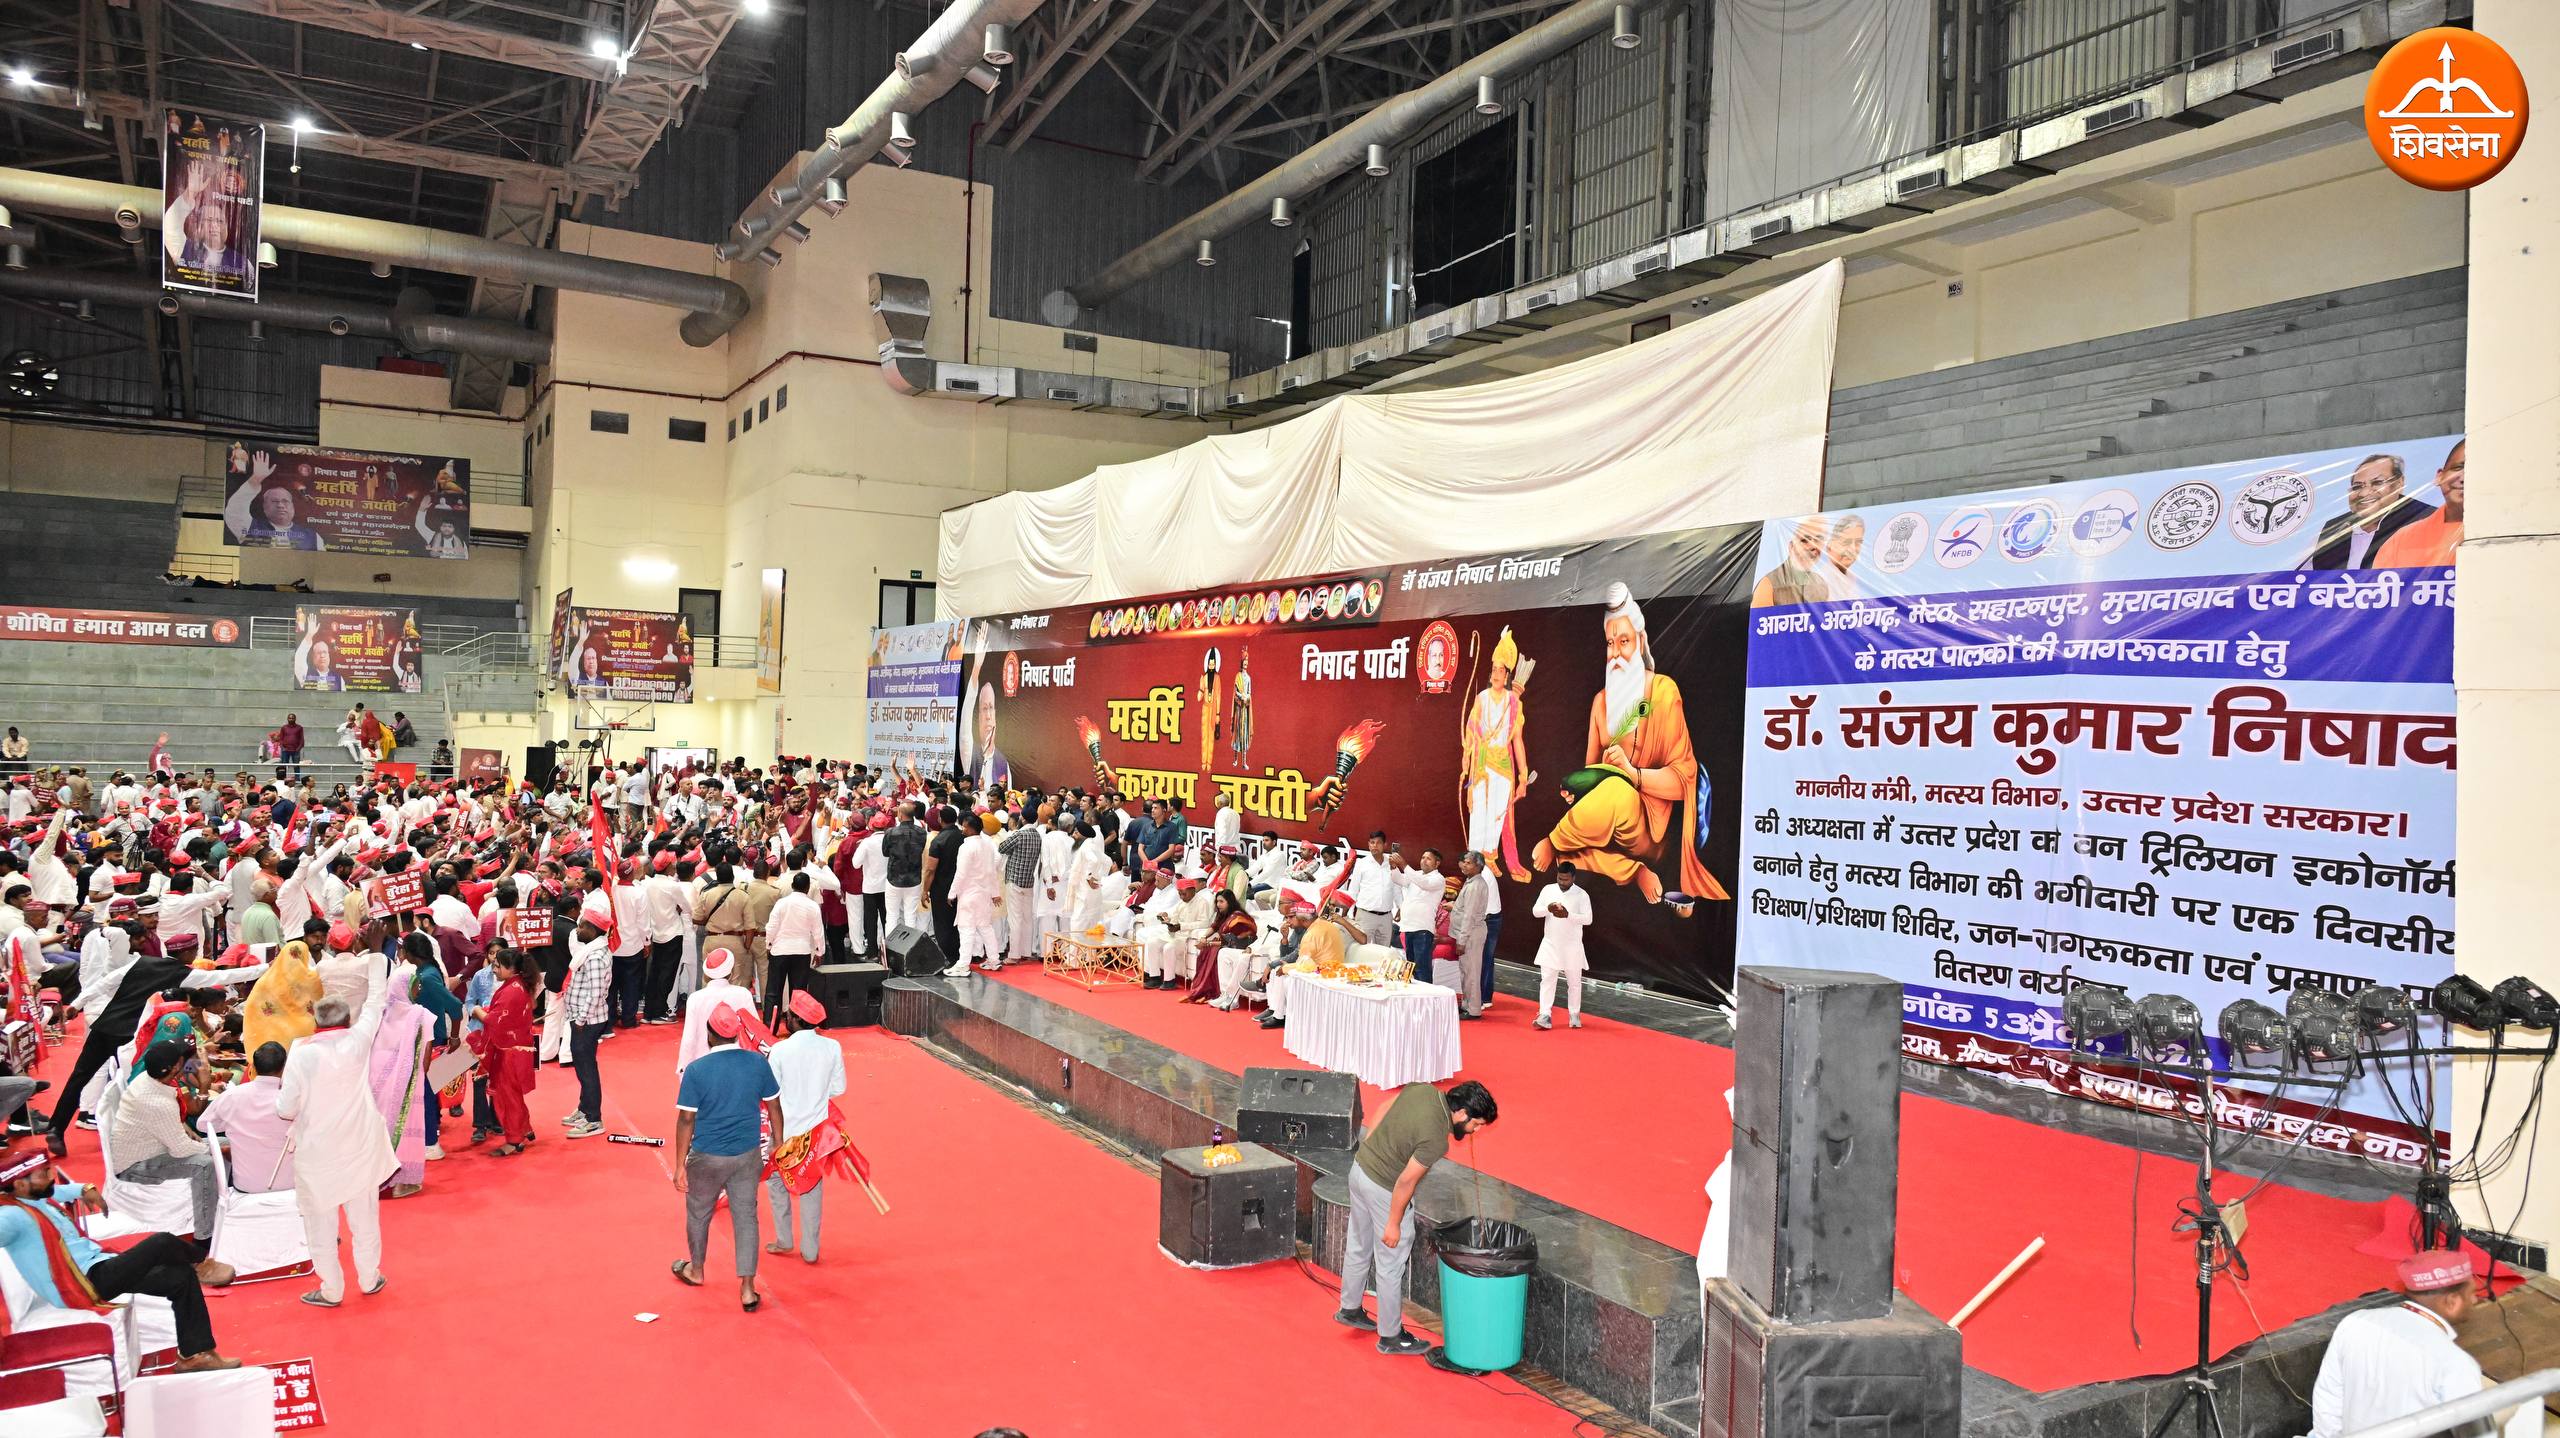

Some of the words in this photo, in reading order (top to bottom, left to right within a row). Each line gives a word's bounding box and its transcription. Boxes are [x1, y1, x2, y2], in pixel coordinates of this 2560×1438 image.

[314, 479, 358, 496] महर्षि
[315, 467, 338, 477] निषाद
[340, 469, 357, 479] पार्टी
[316, 498, 354, 509] कश्यप
[362, 498, 398, 512] जयंती
[1951, 550, 1972, 558] NFDB
[1401, 569, 1417, 591] डॉ
[1417, 566, 1453, 591] संजय
[1454, 562, 1496, 587] निषाद
[1498, 556, 1564, 583] जिंदाबाद
[1756, 612, 1816, 637] आगरा,
[1820, 601, 1902, 633] अलीगढ़,
[1968, 593, 2088, 627] सहारनपुर,
[2100, 585, 2240, 624] मुरादाबाद
[2248, 574, 2307, 610] एवं
[2308, 570, 2404, 610] बरेली
[7, 611, 69, 633] शोषित
[73, 618, 126, 636] हमारा
[129, 621, 171, 638] आम
[175, 623, 208, 639] दल
[1021, 660, 1051, 687] निषाद
[1052, 656, 1076, 687] पार्टी
[1301, 643, 1359, 681] निषाद
[1363, 636, 1410, 680] पार्टी
[1854, 643, 1878, 671] के
[1881, 647, 1937, 670] मत्स्य
[1942, 633, 2020, 667] पालकों
[2021, 631, 2059, 663] की
[2063, 638, 2228, 664] जागरूकता
[2235, 631, 2290, 679] हेतु
[871, 702, 879, 723] डॉ.
[882, 701, 902, 722] संजय
[905, 706, 928, 731] कुमार
[930, 699, 956, 722] निषाद
[1107, 685, 1185, 743] महर्षि
[1763, 694, 1824, 751] डॉ.
[1841, 690, 1979, 749] संजय
[1991, 702, 2191, 775] कुमार
[2206, 685, 2457, 772] निषाद
[1795, 774, 1868, 801] माननीय
[1871, 774, 1917, 805] मंत्री,
[1924, 782, 1985, 805] मत्स्य
[1991, 777, 2069, 812] विभाग,
[2082, 787, 2164, 817] उत्तर
[2172, 790, 2252, 824] प्रदेश
[2263, 802, 2408, 838] सरकार।
[1754, 808, 1779, 835] की
[1786, 815, 1865, 841] अध्यक्षता
[1873, 815, 1895, 843] में
[1900, 823, 1957, 849] उत्तर
[1965, 819, 2019, 852] प्रदेश
[2074, 833, 2128, 861] वन
[2140, 831, 2278, 877] ट्रिलियन
[1753, 851, 1803, 878] बनाने
[1809, 853, 1838, 893] हेतु
[1845, 862, 1901, 888] मत्स्य
[1909, 861, 1979, 896] विभाग
[1987, 868, 2023, 900] की
[2171, 897, 2221, 925] पर
[2232, 904, 2299, 934] एक
[1752, 888, 1886, 932] शिक्षण/प्रशिक्षण
[1892, 904, 1960, 943] शिविर,
[2203, 951, 2261, 986] एवं
[1934, 950, 2014, 988] वितरण
[1984, 1008, 1998, 1029] 5
